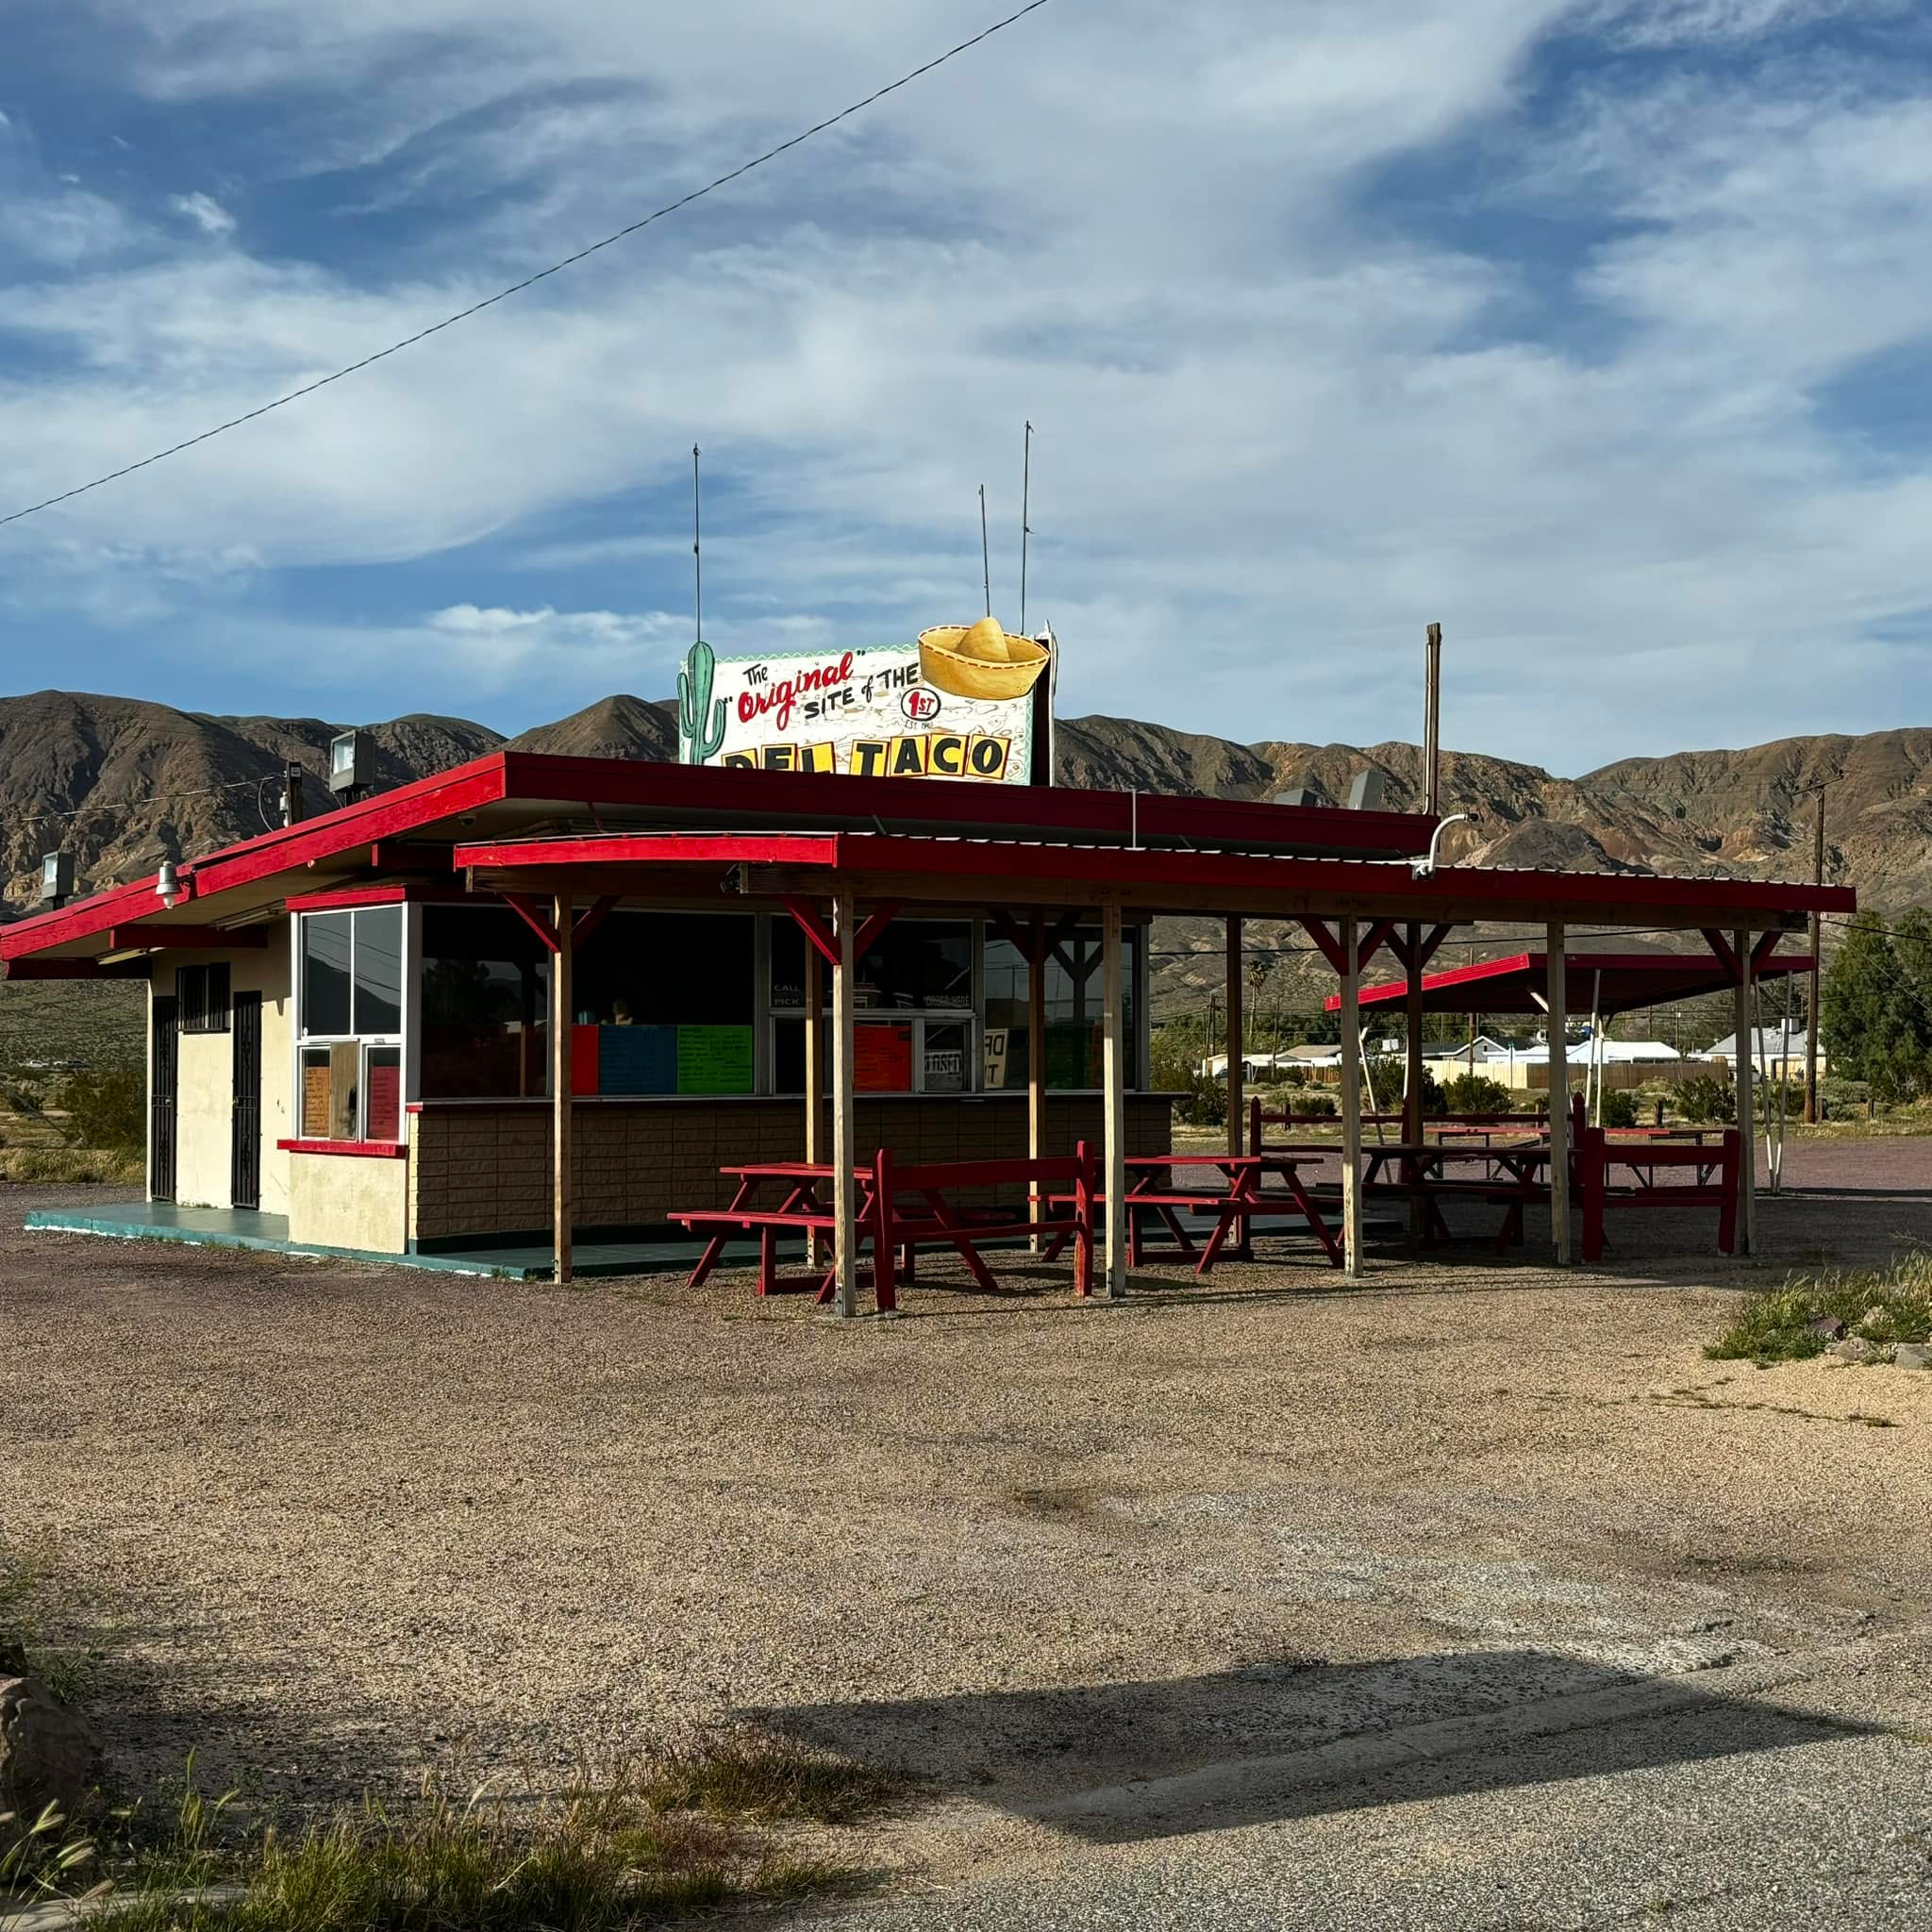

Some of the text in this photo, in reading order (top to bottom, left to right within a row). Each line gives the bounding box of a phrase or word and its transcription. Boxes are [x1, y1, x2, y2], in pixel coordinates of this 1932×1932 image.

[742, 663, 768, 686] The
[804, 662, 919, 720] SITE of THE
[908, 691, 935, 717] 1ST
[857, 738, 1003, 776] TACO
